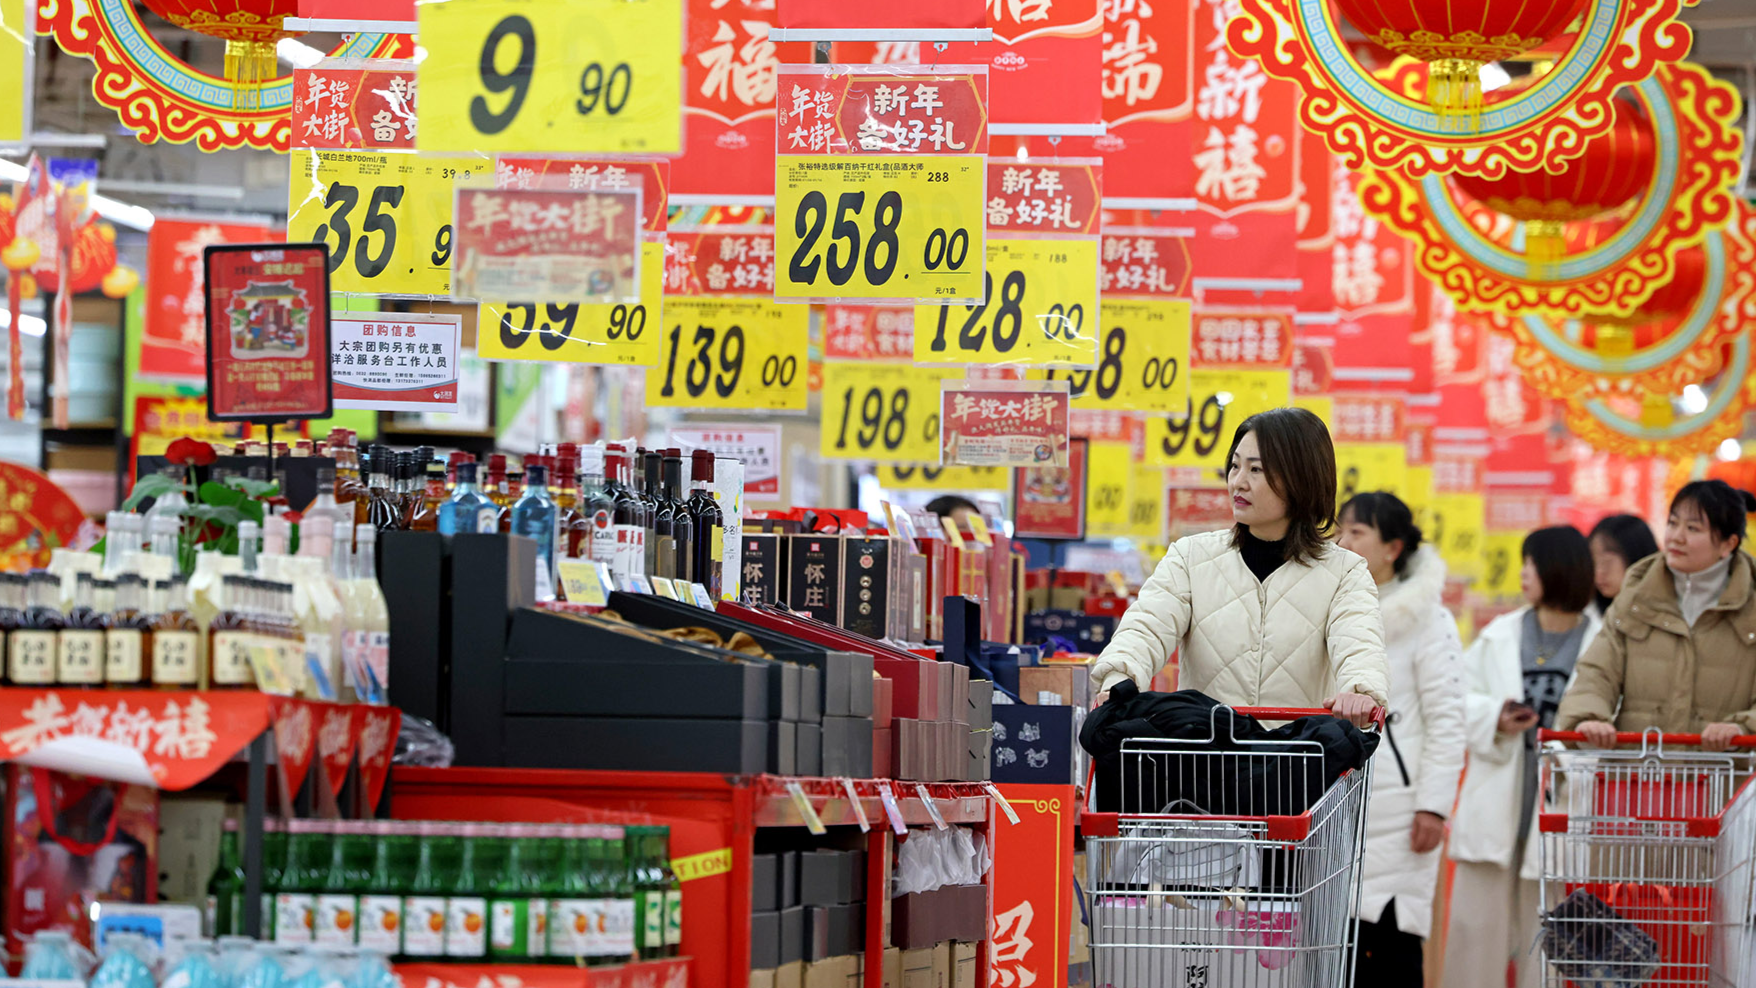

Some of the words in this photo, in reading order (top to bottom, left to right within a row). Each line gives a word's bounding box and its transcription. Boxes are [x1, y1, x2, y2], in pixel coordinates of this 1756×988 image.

[697, 0, 780, 106] 福
[1102, 0, 1162, 106] 瑞
[306, 73, 351, 109] 年货
[789, 84, 835, 121] 年货
[873, 84, 944, 116] 新年
[302, 112, 349, 145] 大街
[788, 124, 836, 153] 大街
[857, 118, 966, 152] 备好礼
[442, 168, 471, 180] 39.8
[569, 163, 630, 191] 新年
[927, 171, 949, 182] 288
[1002, 166, 1063, 198] 新年
[467, 192, 623, 241] 年货大街
[987, 195, 1082, 229] 备好礼
[719, 237, 774, 263] 新年
[1103, 237, 1159, 264] 新年
[363, 324, 417, 338] 团购信息
[339, 340, 443, 355] 大宗团购另有优惠
[950, 393, 1059, 426] 年货大街
[804, 563, 825, 607] 怀庄
